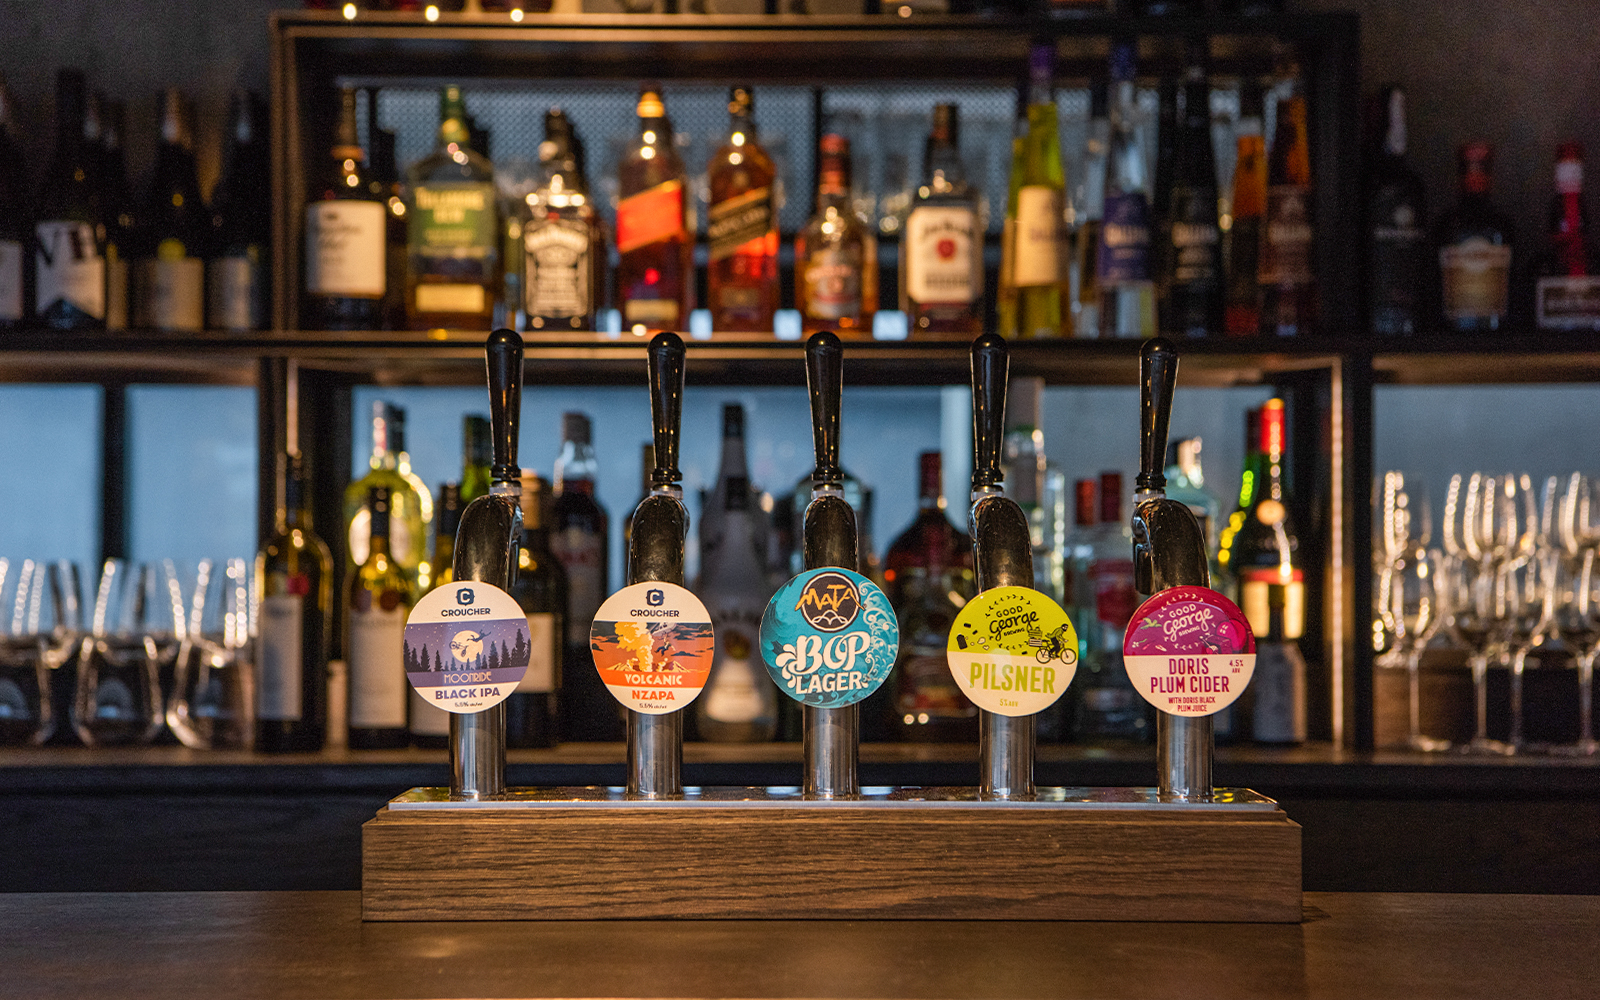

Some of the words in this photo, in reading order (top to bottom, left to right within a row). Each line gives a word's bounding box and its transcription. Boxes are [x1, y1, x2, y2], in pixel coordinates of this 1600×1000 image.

[441, 607, 491, 617] CROUCHER
[630, 609, 680, 618] CROUCHER
[996, 605, 1023, 618] GOOD
[1168, 604, 1197, 618] GOOD
[989, 611, 1040, 642] George
[1163, 608, 1214, 642] George
[1178, 625, 1200, 637] BREWING
[1003, 628, 1025, 637] BREWING
[787, 631, 871, 675] BOP
[1168, 658, 1209, 675] DORIS
[1229, 659, 1244, 667] 4.5%
[443, 671, 492, 684] MOONRIDE
[625, 673, 683, 686] VOLCANIC
[795, 671, 863, 694] LAGER
[969, 662, 1056, 694] PILSNER
[1150, 676, 1186, 693] PLUM
[1189, 676, 1230, 693] CIDER
[435, 688, 477, 700] BLACK
[480, 687, 500, 698] IPA
[631, 690, 675, 700] NZAPA
